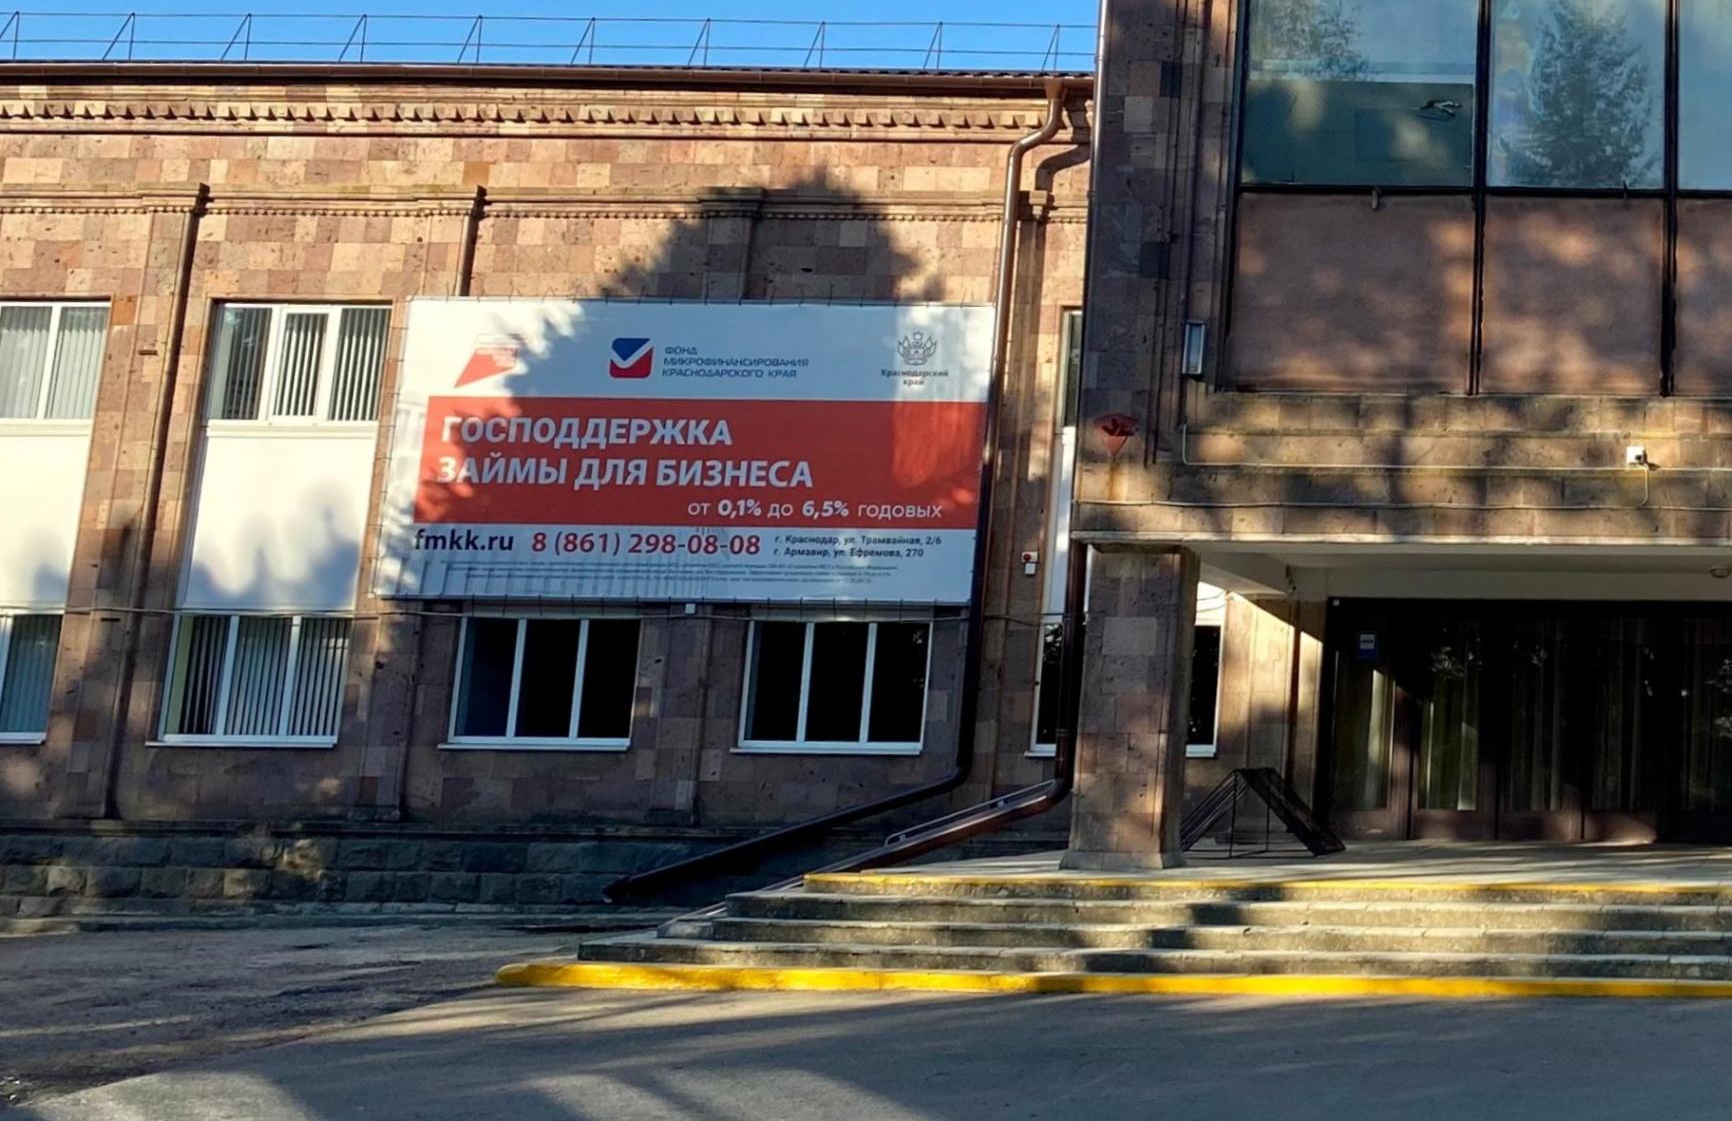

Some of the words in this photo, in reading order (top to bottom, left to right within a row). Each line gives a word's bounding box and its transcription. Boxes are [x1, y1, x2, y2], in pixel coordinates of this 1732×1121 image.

[664, 346, 698, 356] ФОНД
[663, 358, 809, 367] МИКРОФИНАНСИРОВАНИЯ
[662, 368, 764, 378] КРАСНОДАРСКОГО
[768, 370, 797, 378] КРАЯ
[880, 369, 949, 378] Краснодарский
[440, 416, 732, 450] ГОСПОДДЕРЖКА
[436, 452, 567, 486] ЗАЙМЫ
[573, 458, 648, 491] ДЛЯ
[656, 460, 814, 488] БИЗНЕСА
[688, 503, 709, 516] от
[717, 499, 762, 519] 0,1%
[767, 503, 794, 520] до
[802, 499, 850, 521] 6,5%
[857, 504, 943, 520] годовых
[414, 529, 514, 551] fmkk.ru
[531, 532, 547, 553] 8
[554, 531, 621, 556] (861)
[628, 532, 761, 556] 298-08-08
[785, 535, 841, 545] Краснодар,
[861, 535, 923, 545] Трамвайная,
[925, 536, 942, 545] 2/6
[784, 547, 831, 557] Армавир,
[850, 548, 903, 558] Ефремова,
[905, 548, 924, 557] 270
